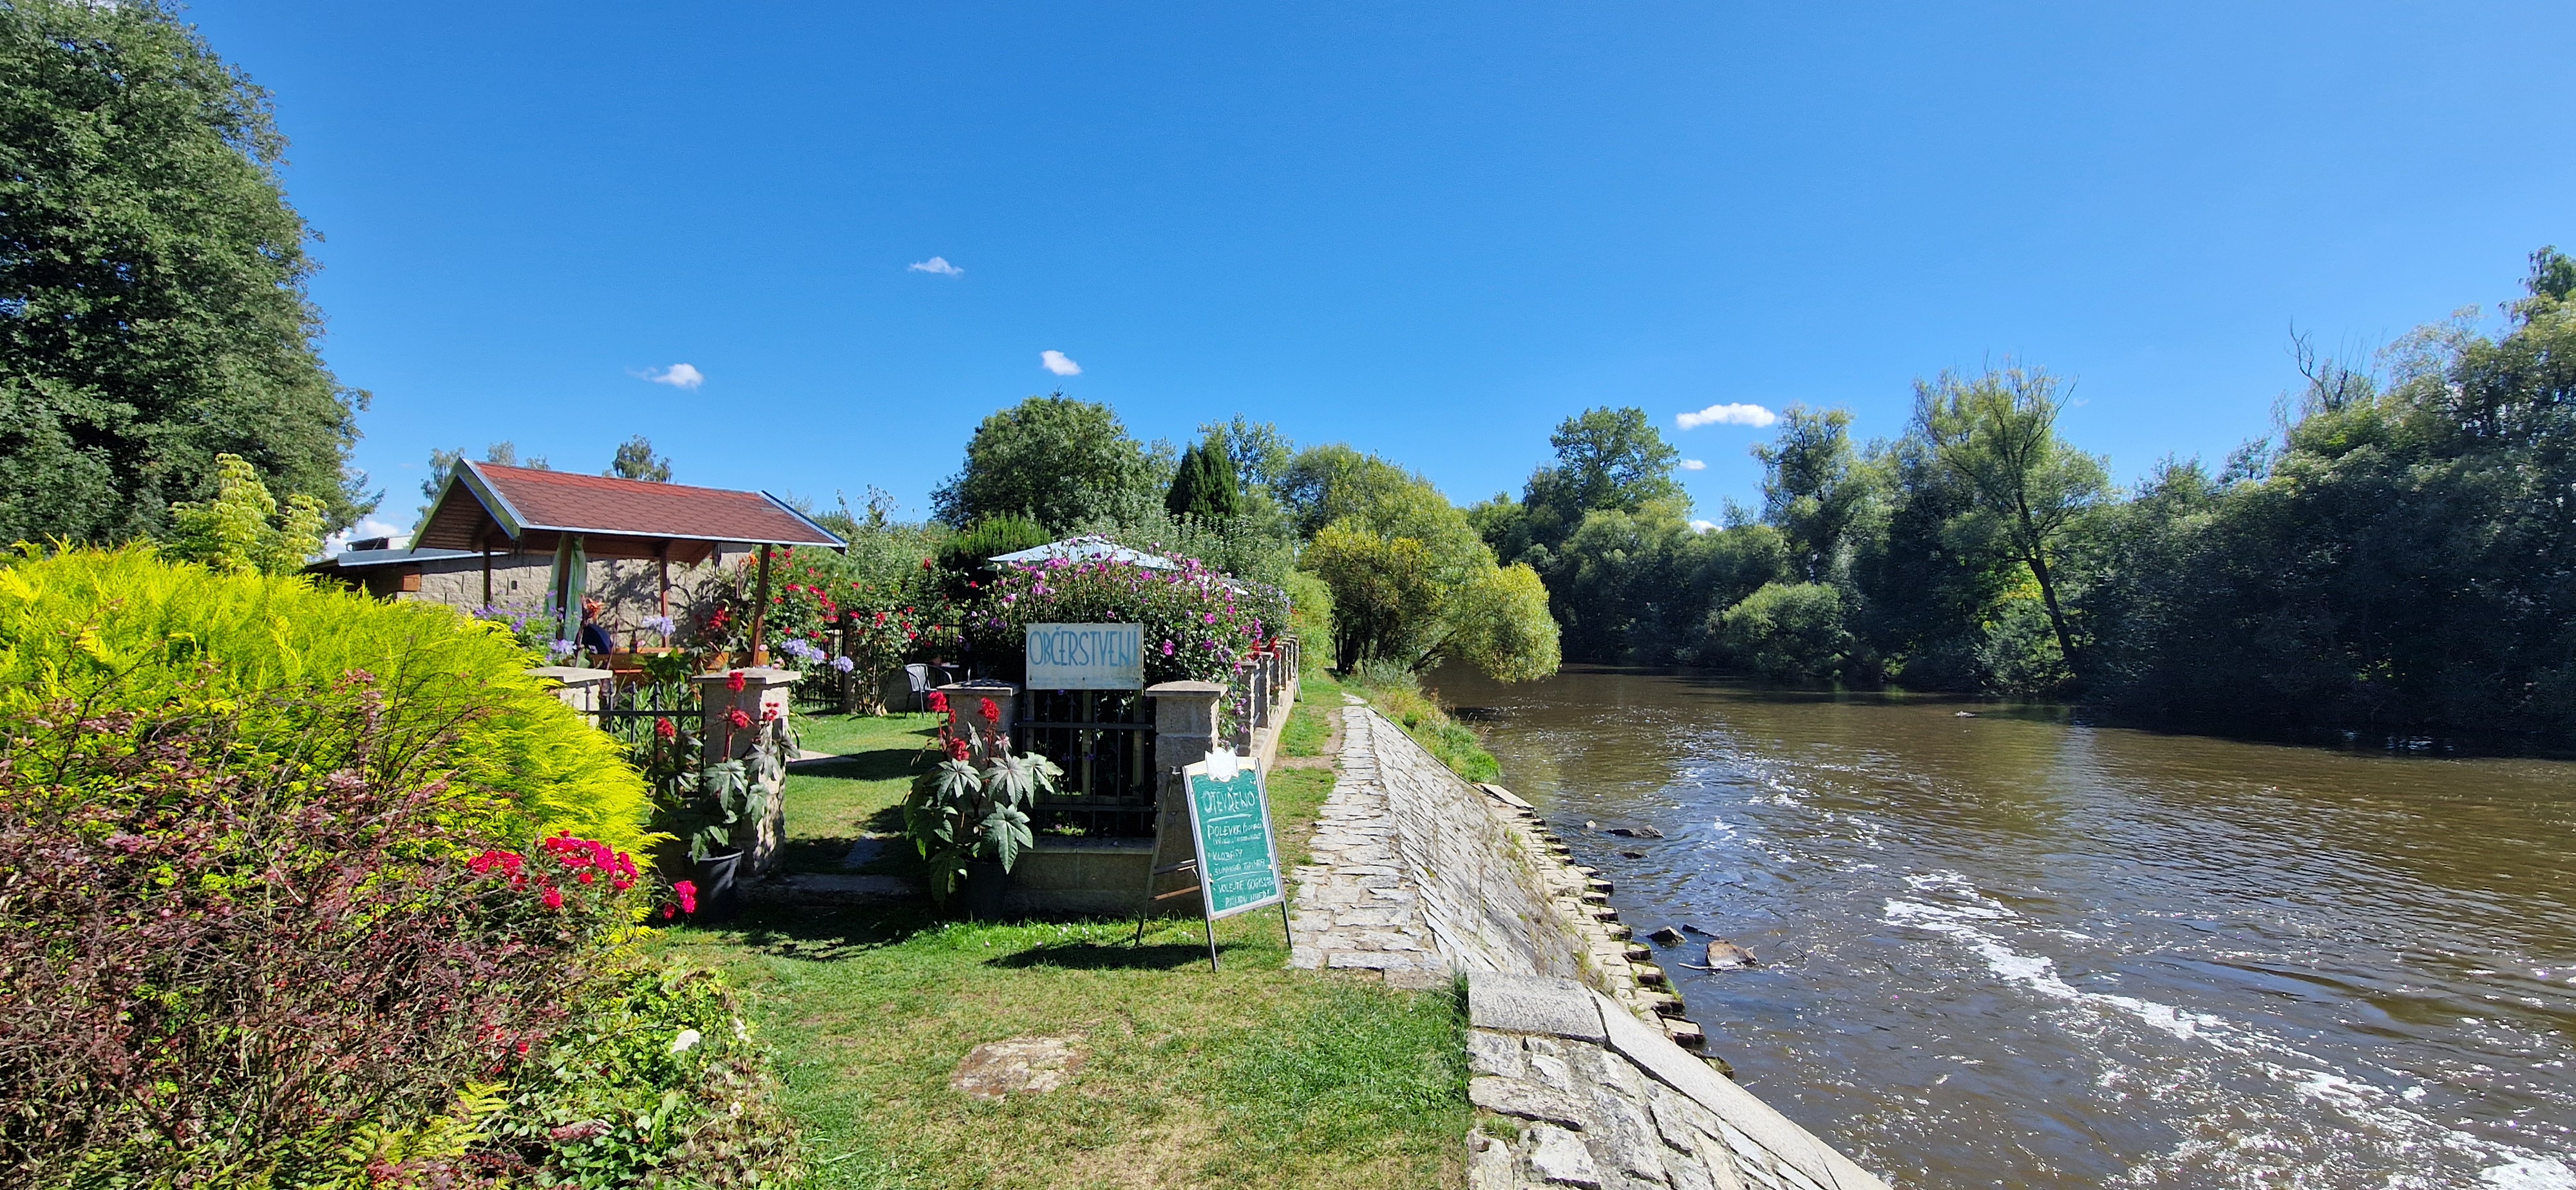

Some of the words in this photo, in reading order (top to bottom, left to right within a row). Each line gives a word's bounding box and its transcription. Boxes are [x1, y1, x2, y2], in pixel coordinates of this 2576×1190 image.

[1029, 626, 1139, 667] OBČERSTVENÍ
[1202, 785, 1255, 815] OTEVŘENO
[1207, 821, 1242, 840] POLÉVKA
[1213, 845, 1243, 860] KLOBÁSY
